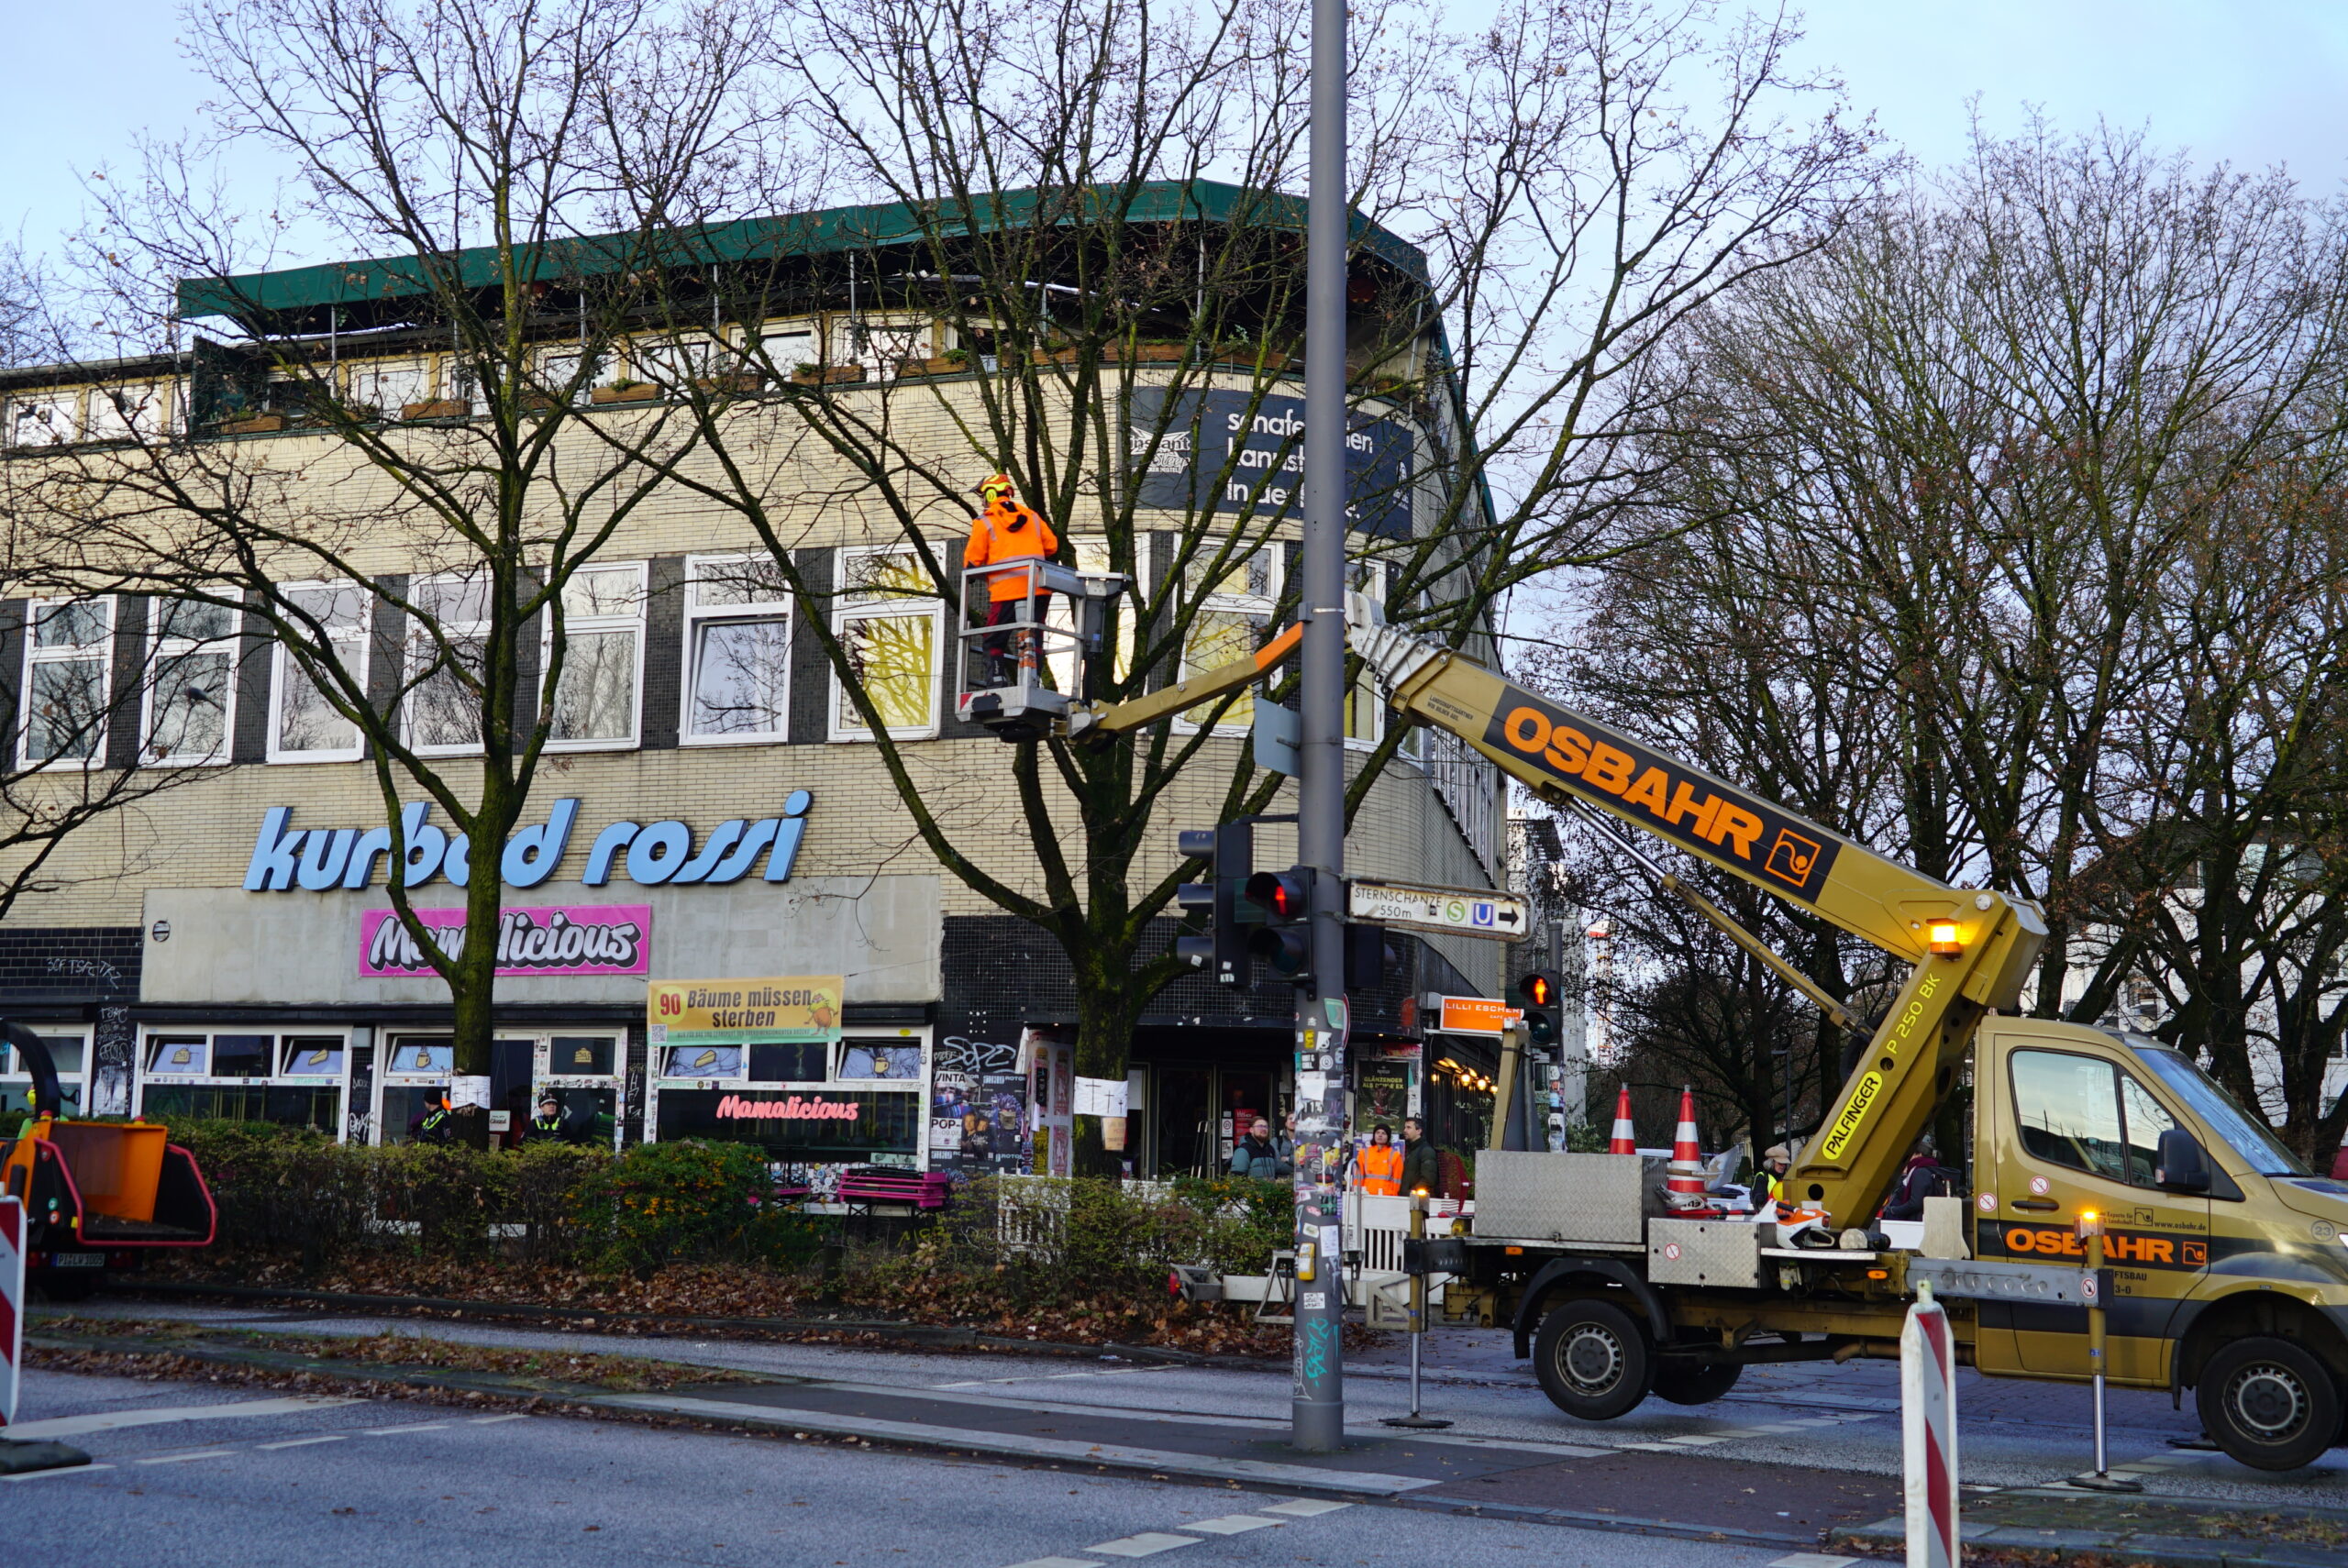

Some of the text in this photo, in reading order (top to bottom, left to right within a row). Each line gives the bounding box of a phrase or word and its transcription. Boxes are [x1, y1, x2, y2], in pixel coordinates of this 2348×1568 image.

[1504, 705, 1765, 862] OSBAHR
[581, 790, 814, 886] rossi
[1355, 887, 1443, 908] STERNSCHANZE
[1379, 904, 1412, 919] 550m
[368, 910, 640, 973] Mmlicious
[659, 987, 812, 1016] 90 Bäume müssen
[1445, 1002, 1471, 1010] LILLI
[712, 1009, 776, 1028] sterben
[1886, 973, 1942, 1055] P 250 BK
[715, 1094, 859, 1121] Mamalicious
[1825, 1076, 1879, 1155] PALFINGER
[2154, 1221, 2207, 1231] www.osbahr.de
[2315, 1225, 2331, 1236] 23
[2114, 1270, 2148, 1281] FTSBAU
[2115, 1284, 2132, 1295] 3-0
